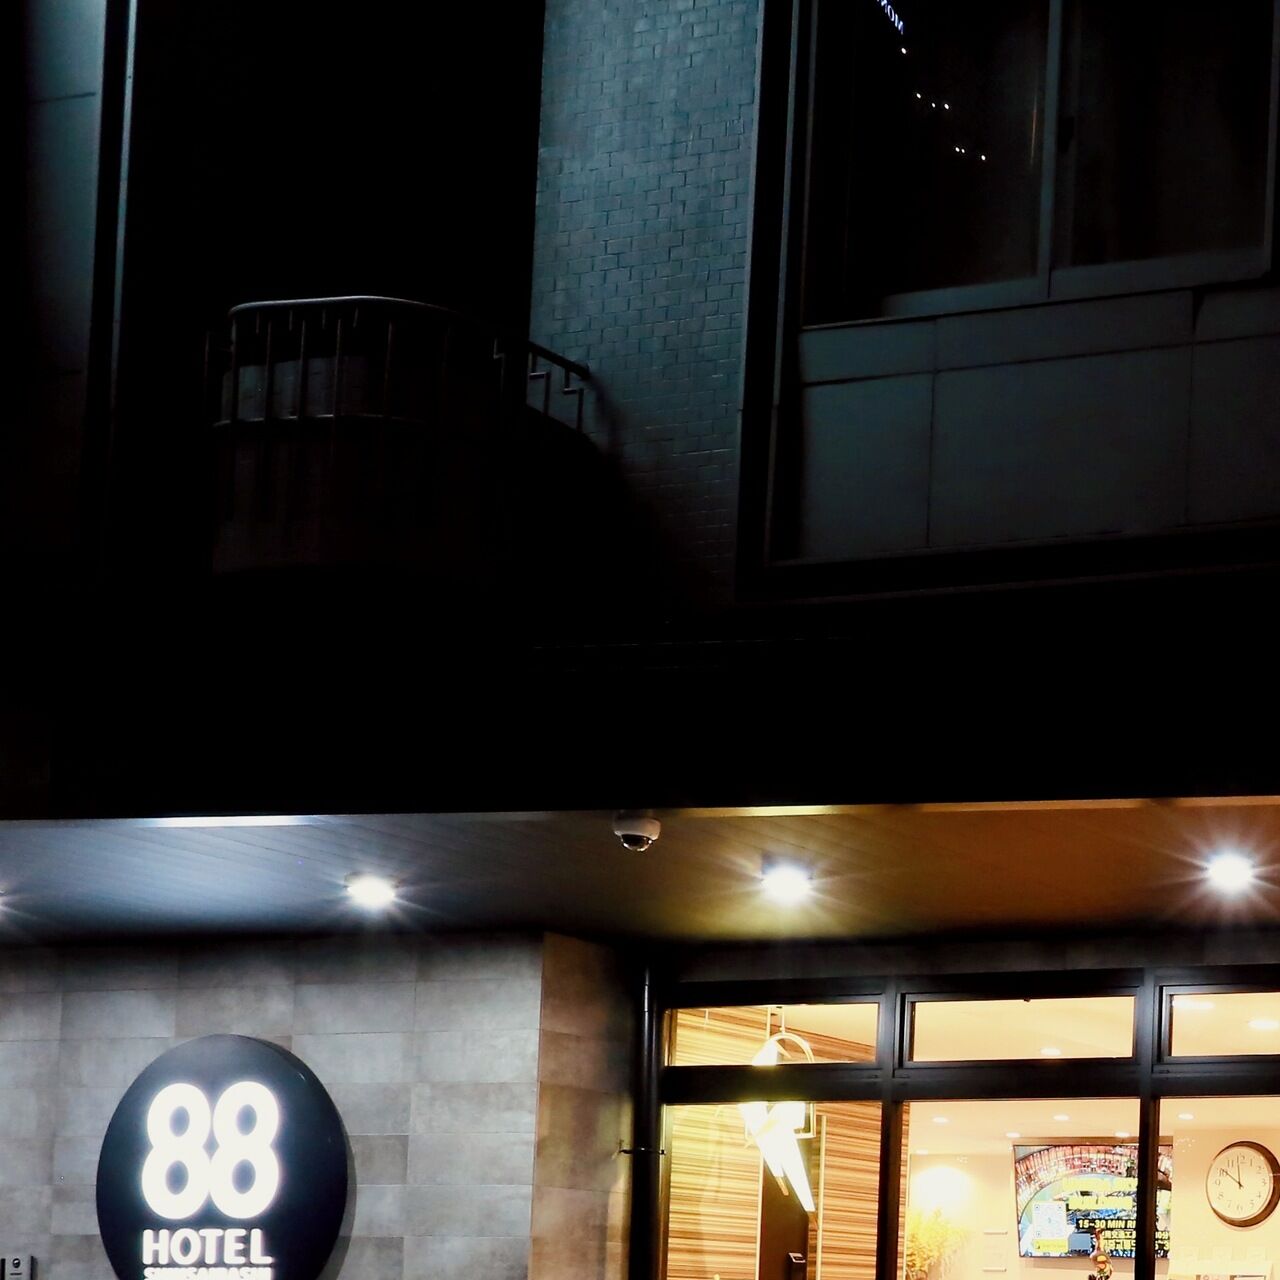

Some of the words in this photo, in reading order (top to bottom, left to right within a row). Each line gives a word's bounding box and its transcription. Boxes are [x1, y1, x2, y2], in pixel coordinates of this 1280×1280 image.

[142, 1081, 279, 1219] 88
[1107, 1219, 1126, 1229] MIN
[1127, 1219, 1137, 1229] RI
[142, 1228, 275, 1265] HOTEL
